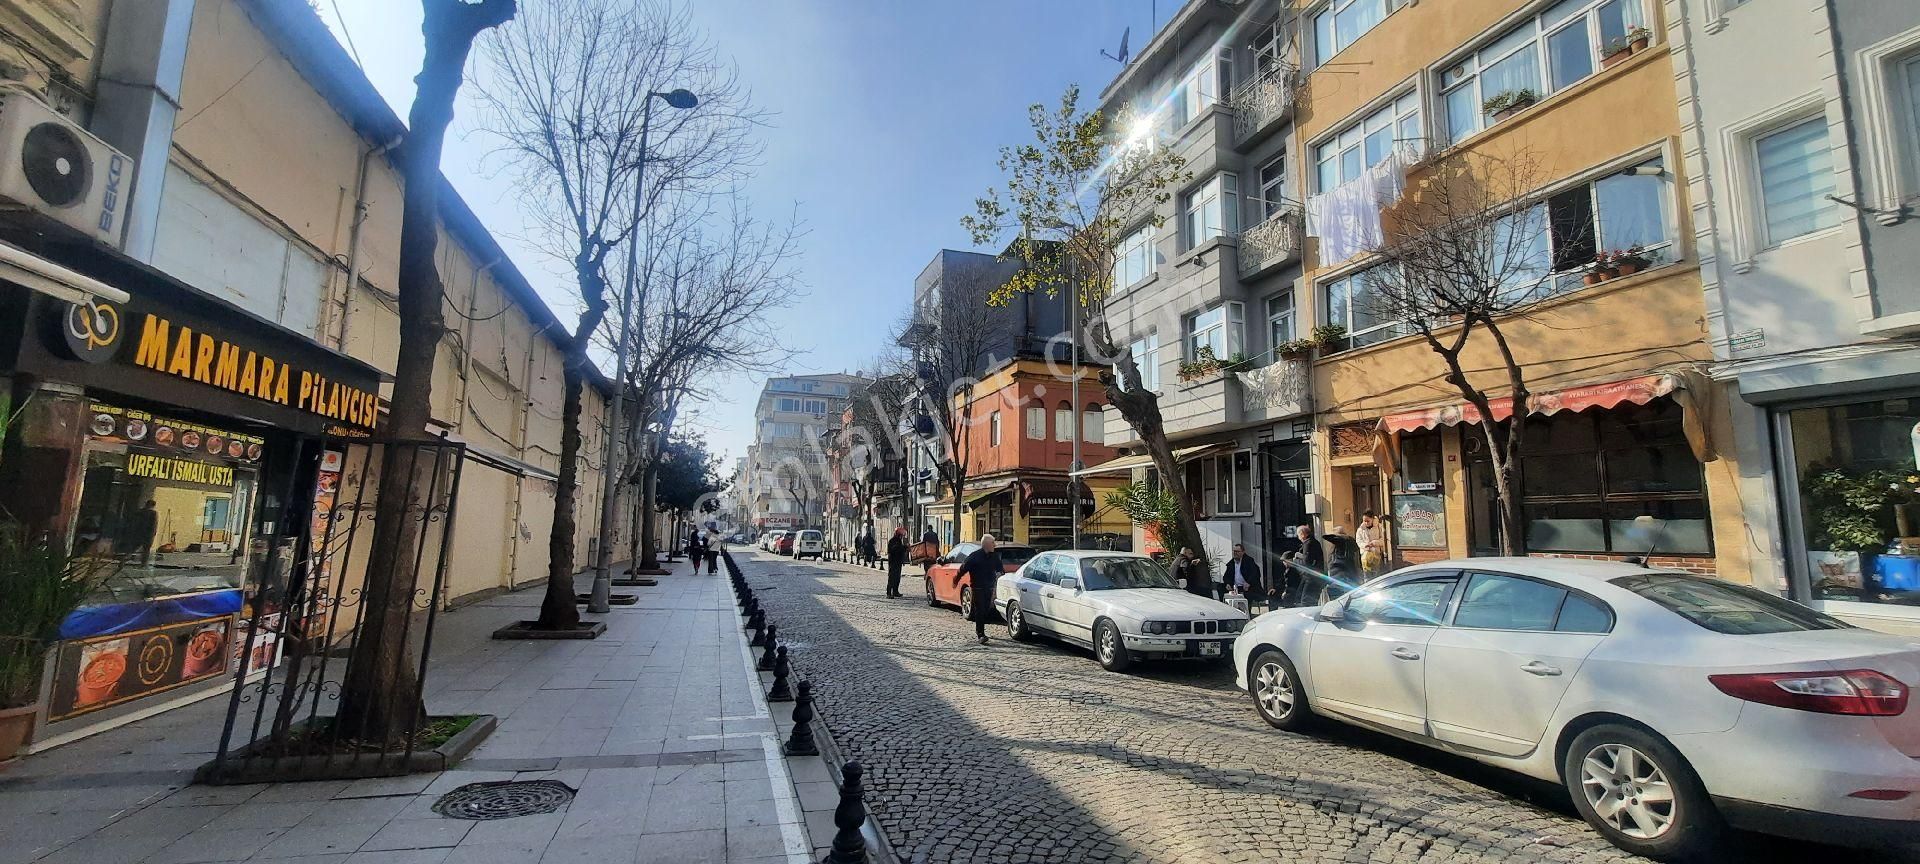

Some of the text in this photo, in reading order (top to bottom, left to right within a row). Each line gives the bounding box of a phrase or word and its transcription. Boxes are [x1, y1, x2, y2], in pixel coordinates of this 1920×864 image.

[99, 154, 123, 233] BEKO
[135, 313, 290, 406] MARMARA
[128, 453, 233, 487] URFALI İSMAİL USTA
